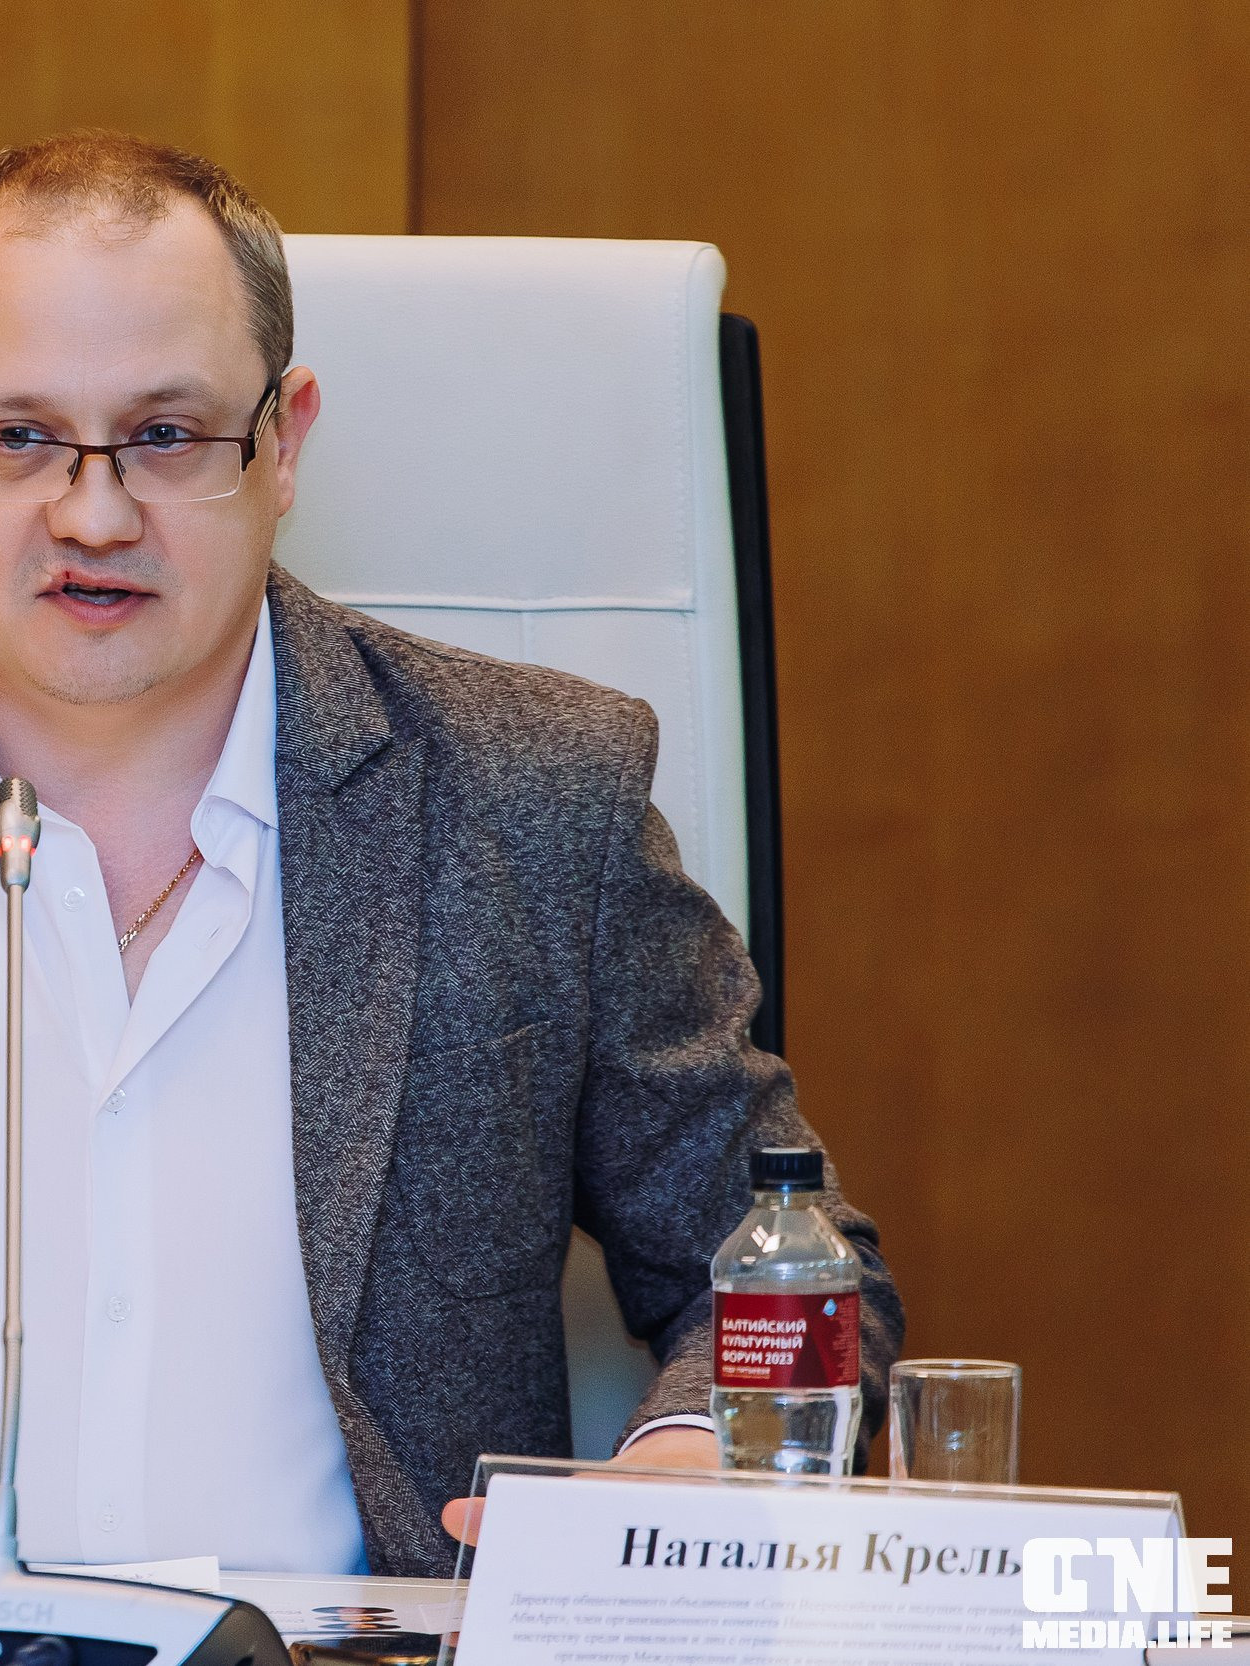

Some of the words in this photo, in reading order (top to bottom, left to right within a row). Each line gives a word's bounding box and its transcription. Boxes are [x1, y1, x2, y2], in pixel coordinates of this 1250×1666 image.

[722, 1333, 803, 1349] КУЛЬТУРНЫЙ
[722, 1349, 763, 1364] ФОРУМ
[765, 1351, 794, 1366] 2023
[617, 1525, 843, 1571] Наталья
[862, 1532, 1022, 1587] Крель
